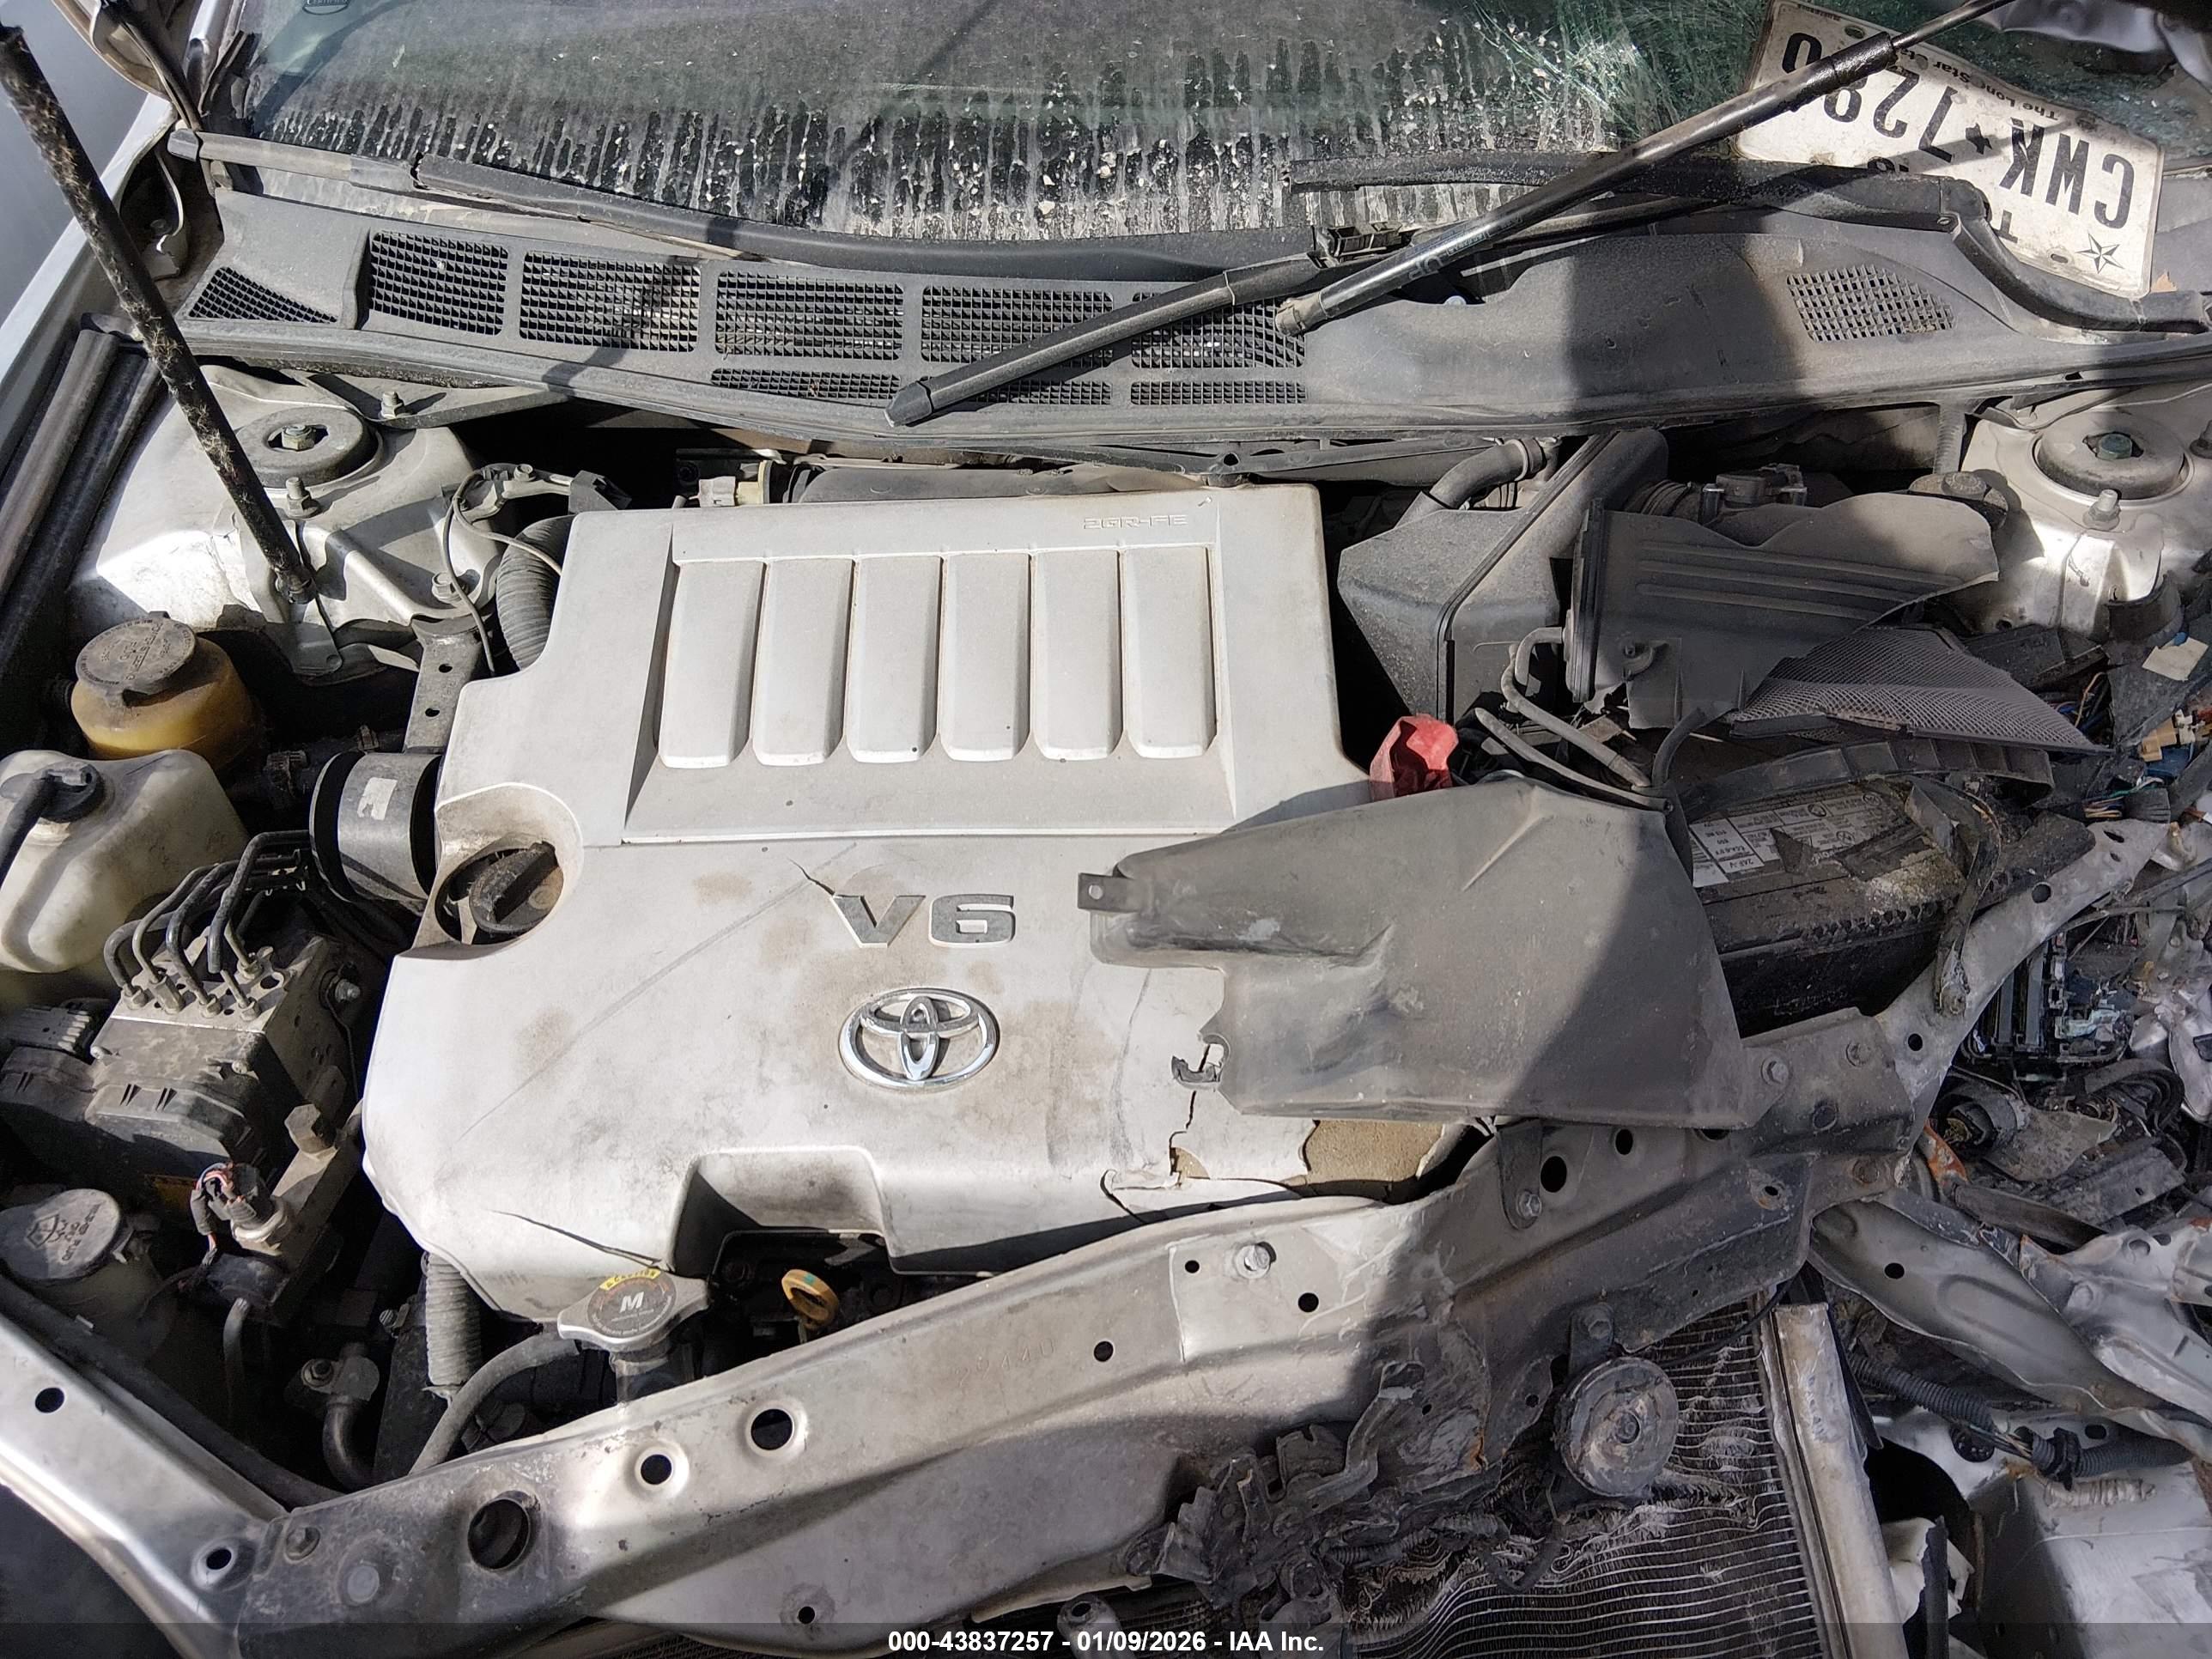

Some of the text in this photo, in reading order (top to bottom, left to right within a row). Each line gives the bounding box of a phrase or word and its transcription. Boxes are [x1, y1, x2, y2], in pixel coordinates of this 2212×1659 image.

[1932, 59, 1972, 84] Star
[2021, 100, 2059, 121] The
[1998, 117, 2136, 229] CWK
[1083, 514, 1189, 531] 2GR-FE
[829, 893, 1017, 948] V6
[618, 1291, 645, 1315] M
